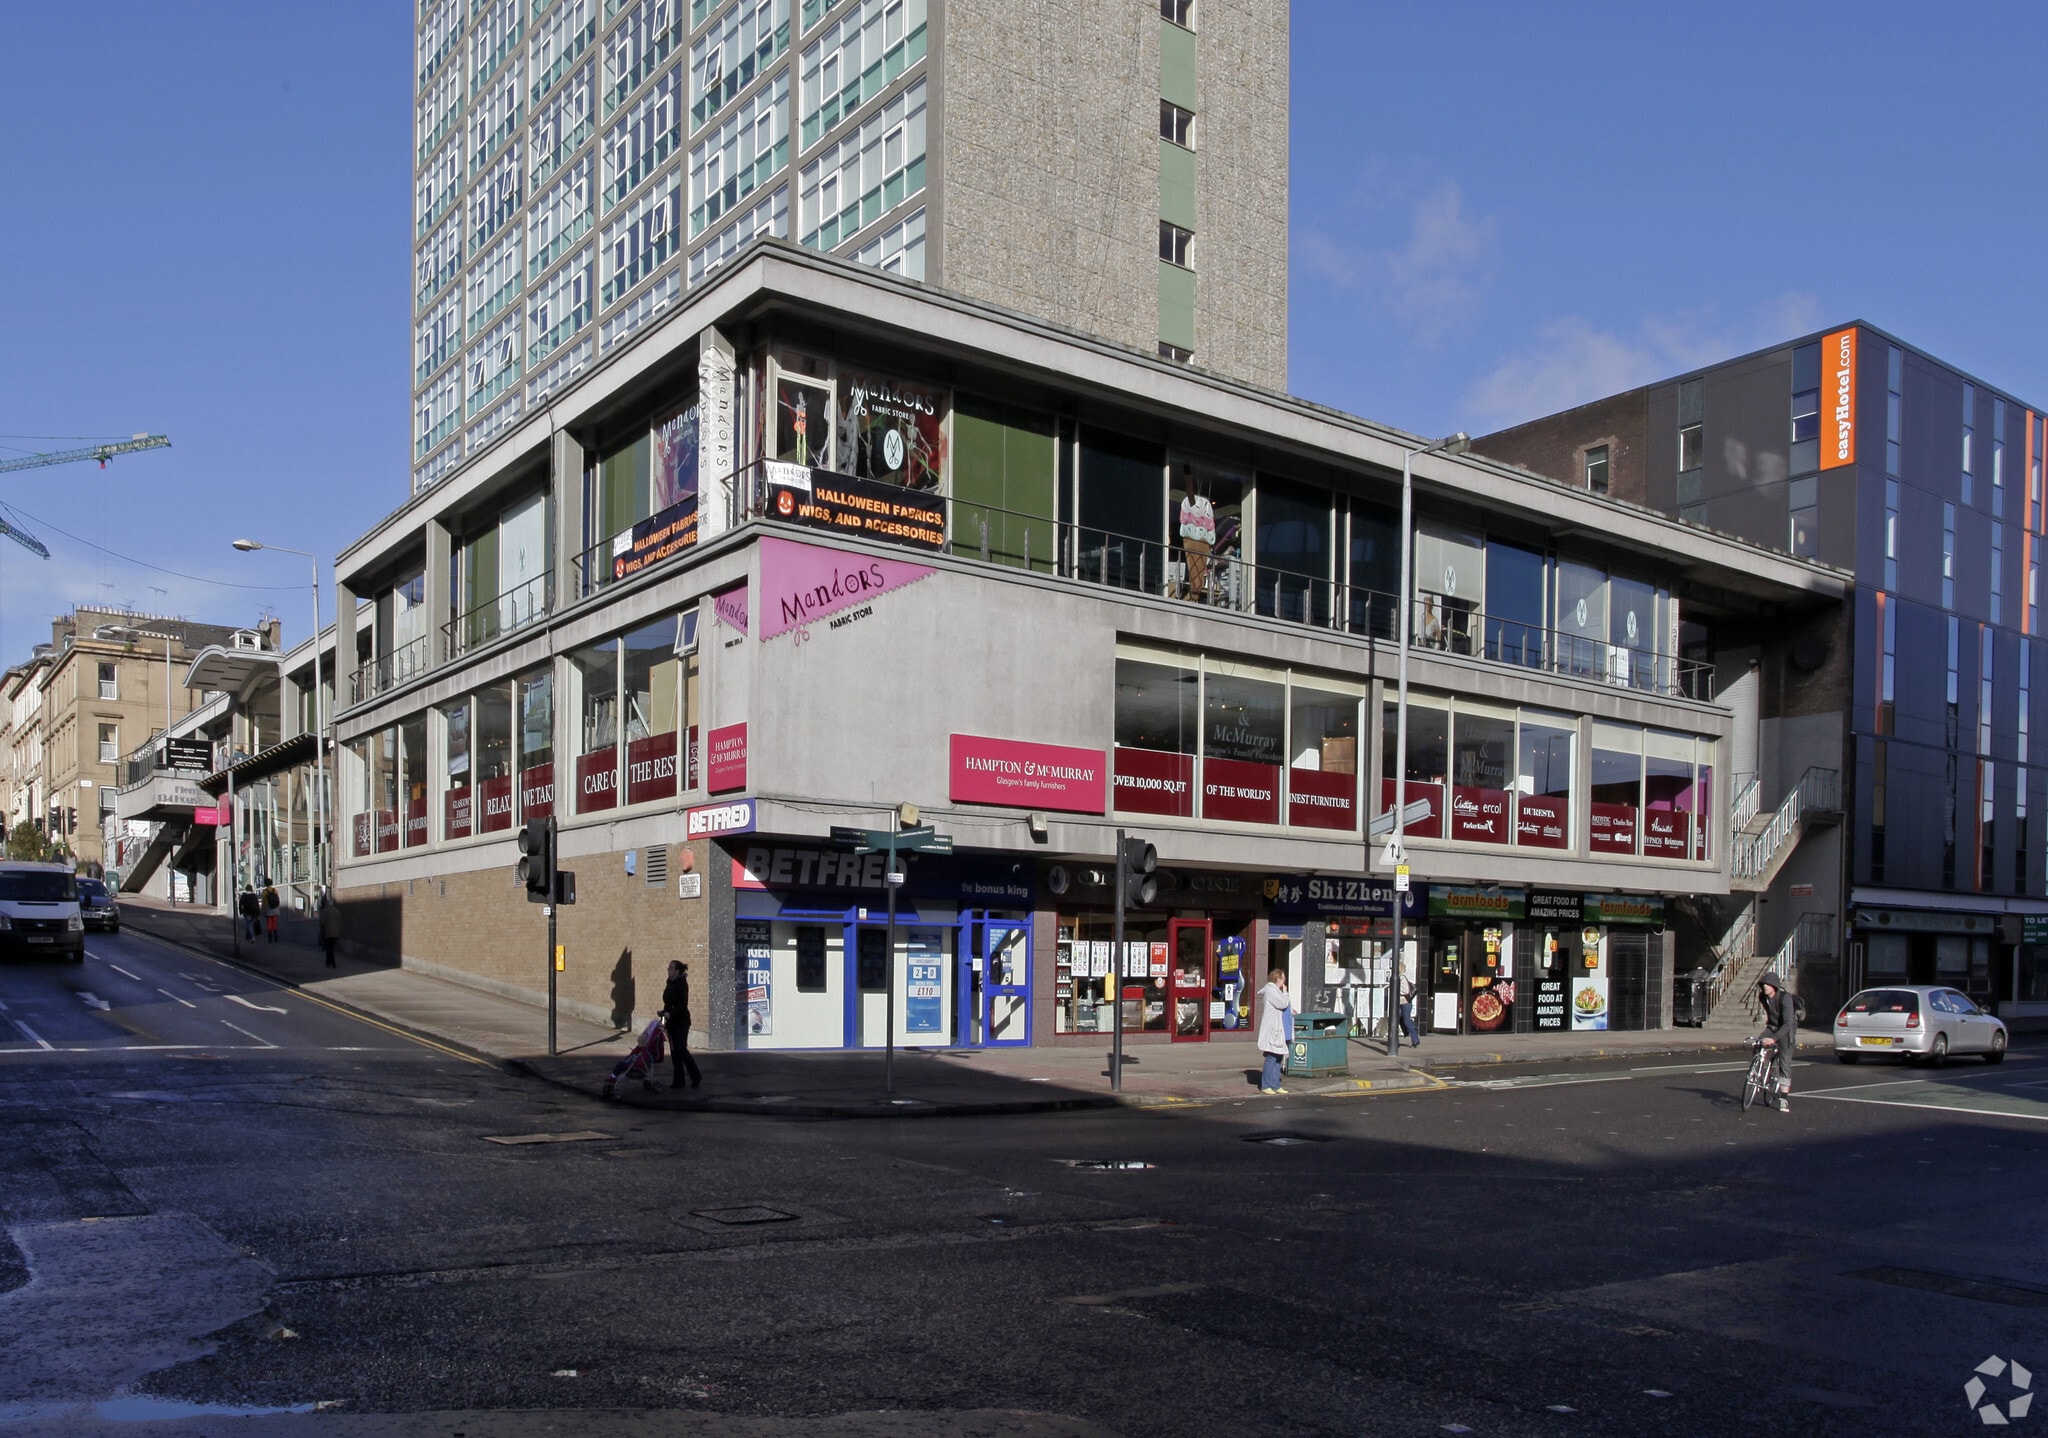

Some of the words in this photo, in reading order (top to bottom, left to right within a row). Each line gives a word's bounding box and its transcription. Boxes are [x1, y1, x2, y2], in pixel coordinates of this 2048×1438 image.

[1835, 334, 1852, 460] easyHotel.com
[871, 404, 891, 416] FABRIC
[891, 409, 910, 420] STORE
[816, 487, 890, 515] HALLOWEEN
[892, 505, 945, 528] FABRICS,
[798, 504, 833, 524] WIGS,
[834, 512, 862, 527] AND
[864, 518, 944, 545] ACCESSORIES
[633, 525, 671, 553] HALLOWEEN
[643, 551, 656, 567] AND
[655, 529, 698, 560] ACCESSORIE
[829, 614, 853, 631] FABRIC
[852, 605, 873, 621] STORE
[1238, 710, 1251, 727] &
[714, 736, 744, 752] HAMPTON
[1213, 724, 1278, 751] McMurray
[965, 756, 1022, 774] HAMPTON
[1023, 760, 1036, 776] &
[583, 770, 609, 795] CARE
[630, 761, 652, 785] THE
[653, 755, 679, 779] REST
[996, 776, 1023, 787] Glasgow's
[1023, 778, 1041, 790] family
[1040, 780, 1066, 791] furnishers
[1113, 774, 1135, 787] OVER
[1135, 777, 1162, 791] 10,000
[1163, 779, 1187, 794] SQ.FT
[157, 794, 173, 803] 134
[1206, 784, 1218, 795] OF
[1219, 786, 1236, 797] THE
[1236, 788, 1271, 801] WORLD'S
[486, 794, 512, 816] RELAX.
[522, 790, 536, 808] WE
[1289, 793, 1310, 806] INEST
[1310, 795, 1350, 809] FURNITURE
[1482, 802, 1502, 814] ercol
[688, 803, 751, 835] BETFRED
[1522, 807, 1556, 819] DURESTA
[743, 846, 908, 889] BETFRED
[961, 883, 973, 894] the
[975, 882, 1005, 895] bonus
[1007, 884, 1029, 898] king
[1308, 879, 1395, 902] ShiZhen
[1446, 890, 1510, 910] farmfoods
[1532, 895, 1552, 905] GREAT
[1553, 896, 1570, 906] FOOD
[1570, 897, 1579, 906] AT
[1599, 899, 1652, 916] farmfoods
[1530, 908, 1558, 918] AMAZING
[1558, 908, 1580, 919] PRICES
[736, 926, 766, 934] GOALS
[735, 943, 770, 959] BIGGER
[744, 959, 759, 969] AND
[735, 969, 770, 985] BETTER
[916, 986, 934, 996] £110
[1540, 981, 1561, 992] GREAT
[1315, 989, 1332, 1004] £5
[1538, 993, 1554, 1004] FOOD
[1554, 993, 1564, 1003] AT
[1536, 1005, 1564, 1015] AMAZING
[1539, 1017, 1561, 1027] PRICES
